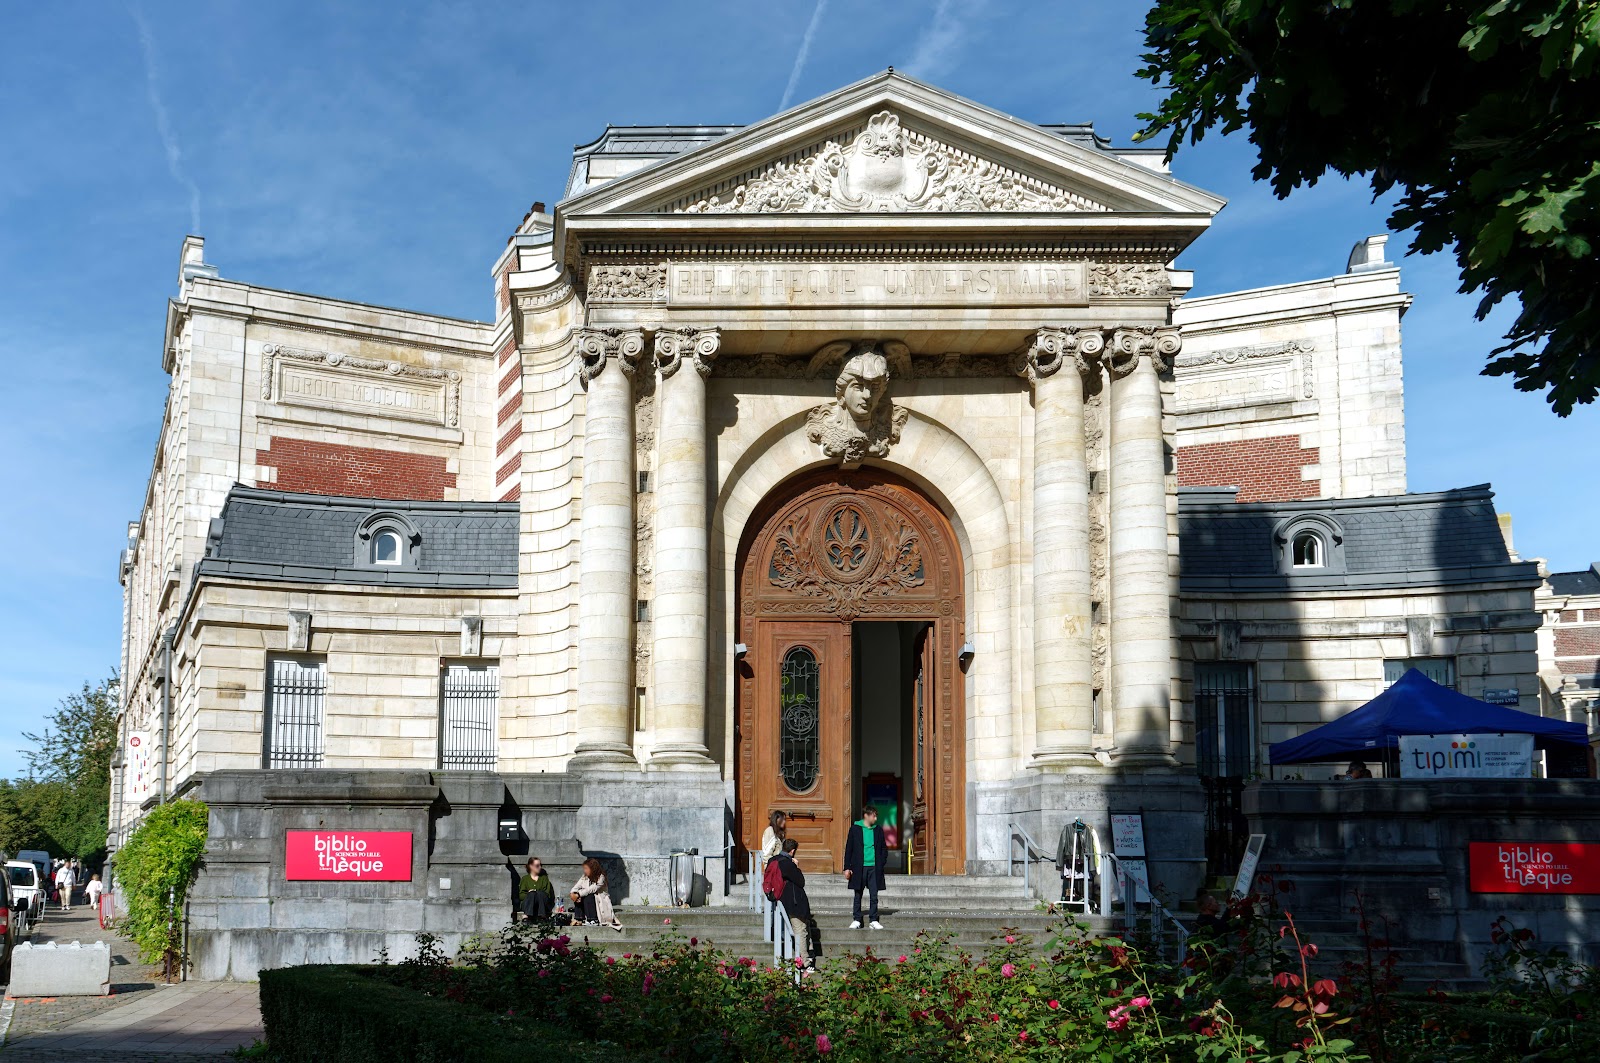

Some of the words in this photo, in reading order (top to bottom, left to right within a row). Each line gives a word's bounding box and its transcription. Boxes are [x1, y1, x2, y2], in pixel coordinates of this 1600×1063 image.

[678, 270, 856, 296] BIBLIOTHEQUE
[883, 269, 1076, 295] UNIVERSITAIRE
[289, 375, 340, 399] DROIT
[1412, 748, 1481, 775] tipimi
[314, 834, 367, 851] biblio
[1498, 846, 1553, 863] biblio
[318, 852, 384, 877] thèque
[1503, 864, 1573, 889] thèque
